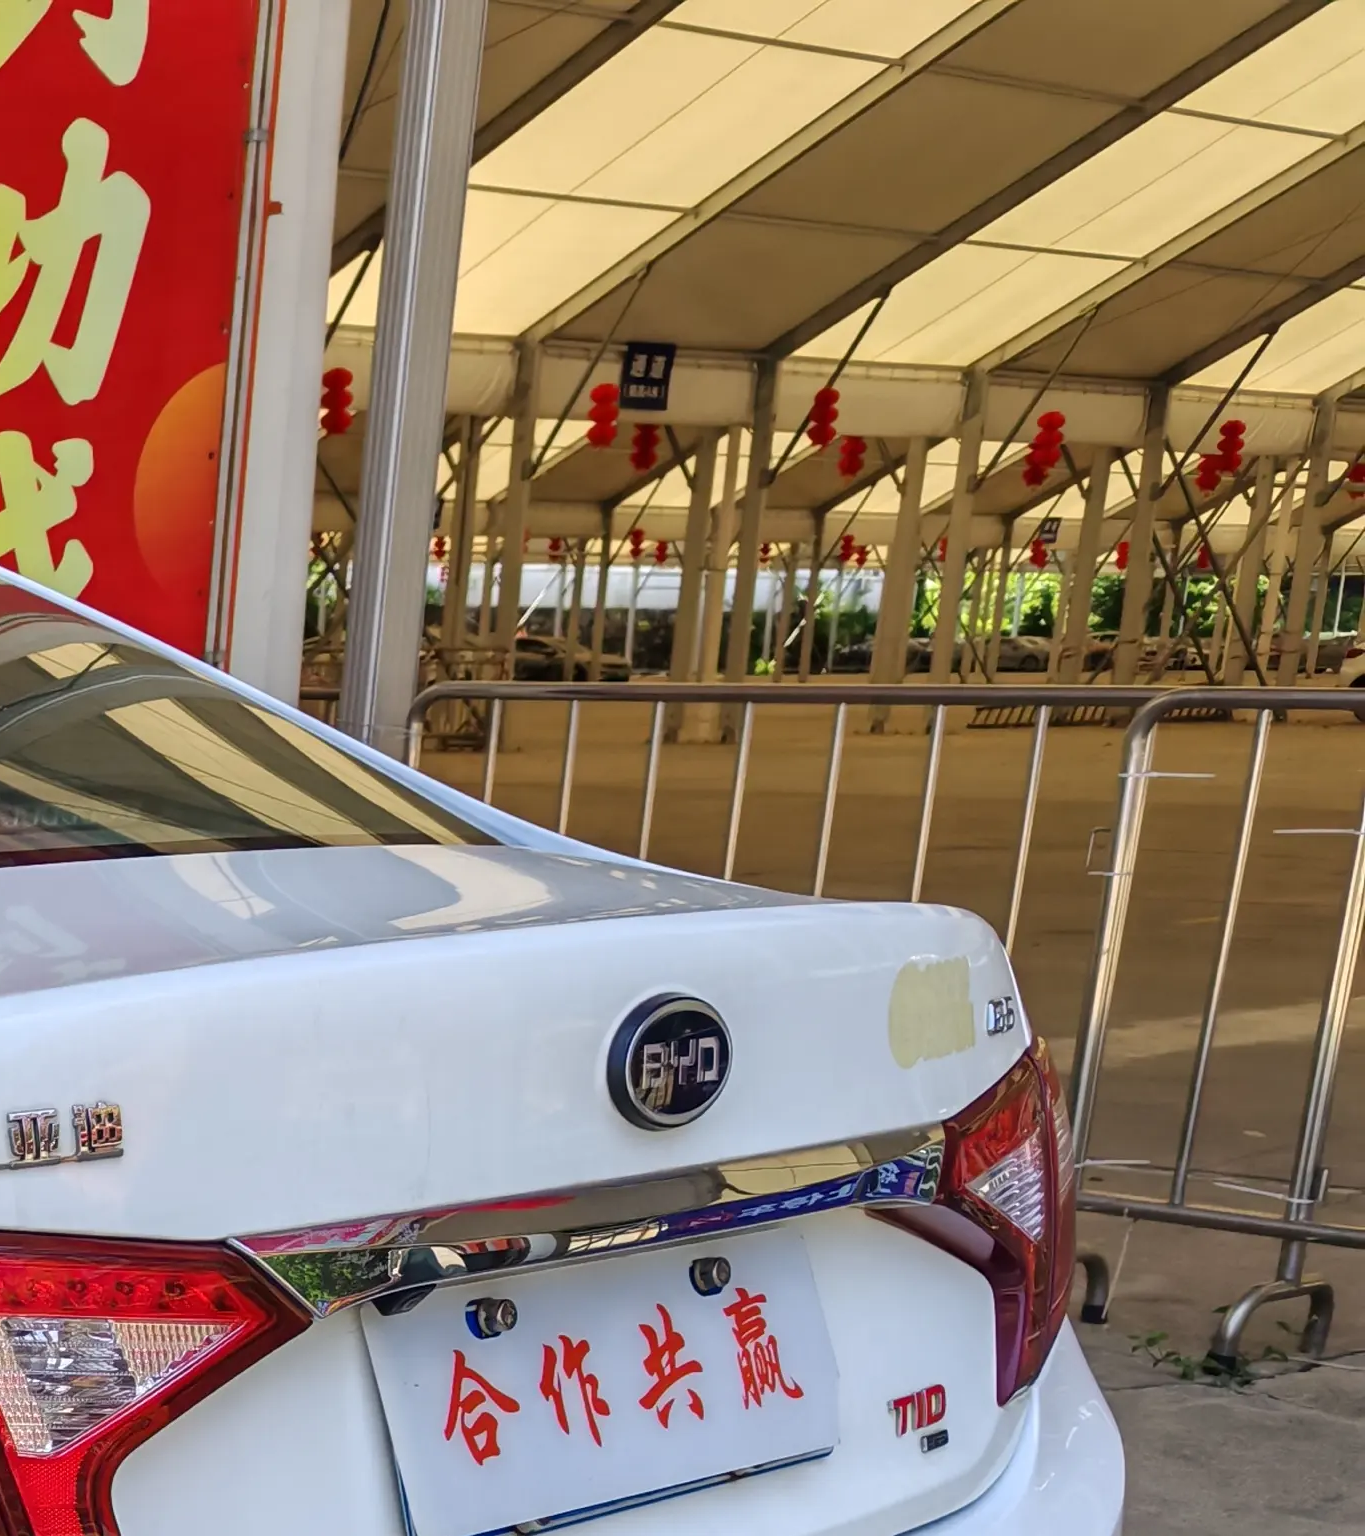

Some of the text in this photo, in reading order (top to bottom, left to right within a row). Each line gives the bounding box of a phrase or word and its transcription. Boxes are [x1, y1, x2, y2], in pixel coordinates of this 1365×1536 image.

[641, 1036, 720, 1090] BYD
[442, 1287, 805, 1467] 合作共赢
